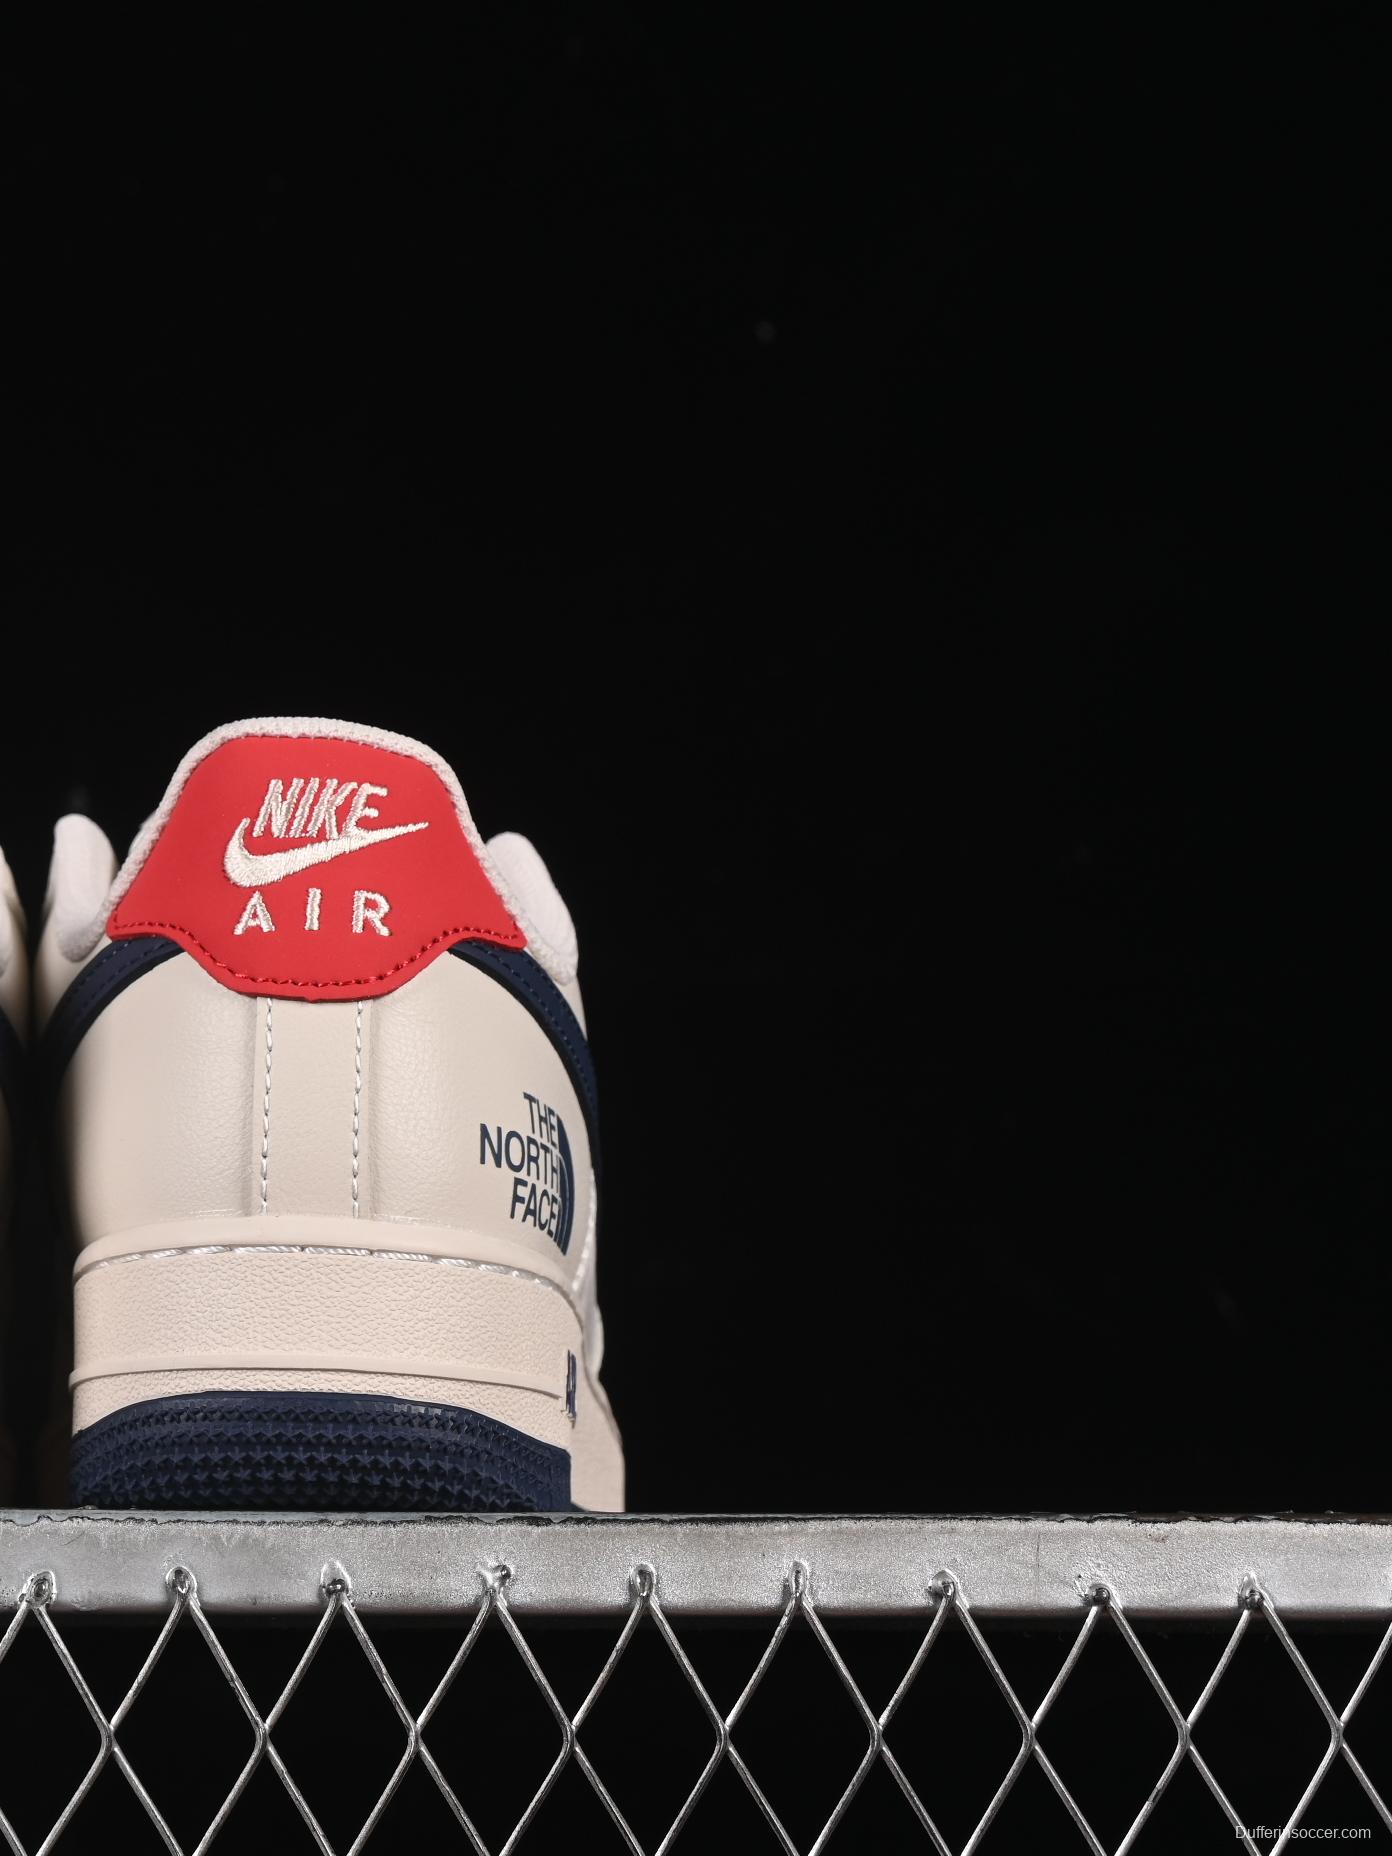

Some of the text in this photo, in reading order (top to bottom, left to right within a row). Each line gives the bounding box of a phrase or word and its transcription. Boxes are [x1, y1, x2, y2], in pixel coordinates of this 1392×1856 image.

[252, 777, 388, 838] NIKE
[233, 888, 392, 936] AIR
[523, 1091, 558, 1150] THE
[479, 1122, 560, 1194] NORTH
[510, 1176, 558, 1238] FACE
